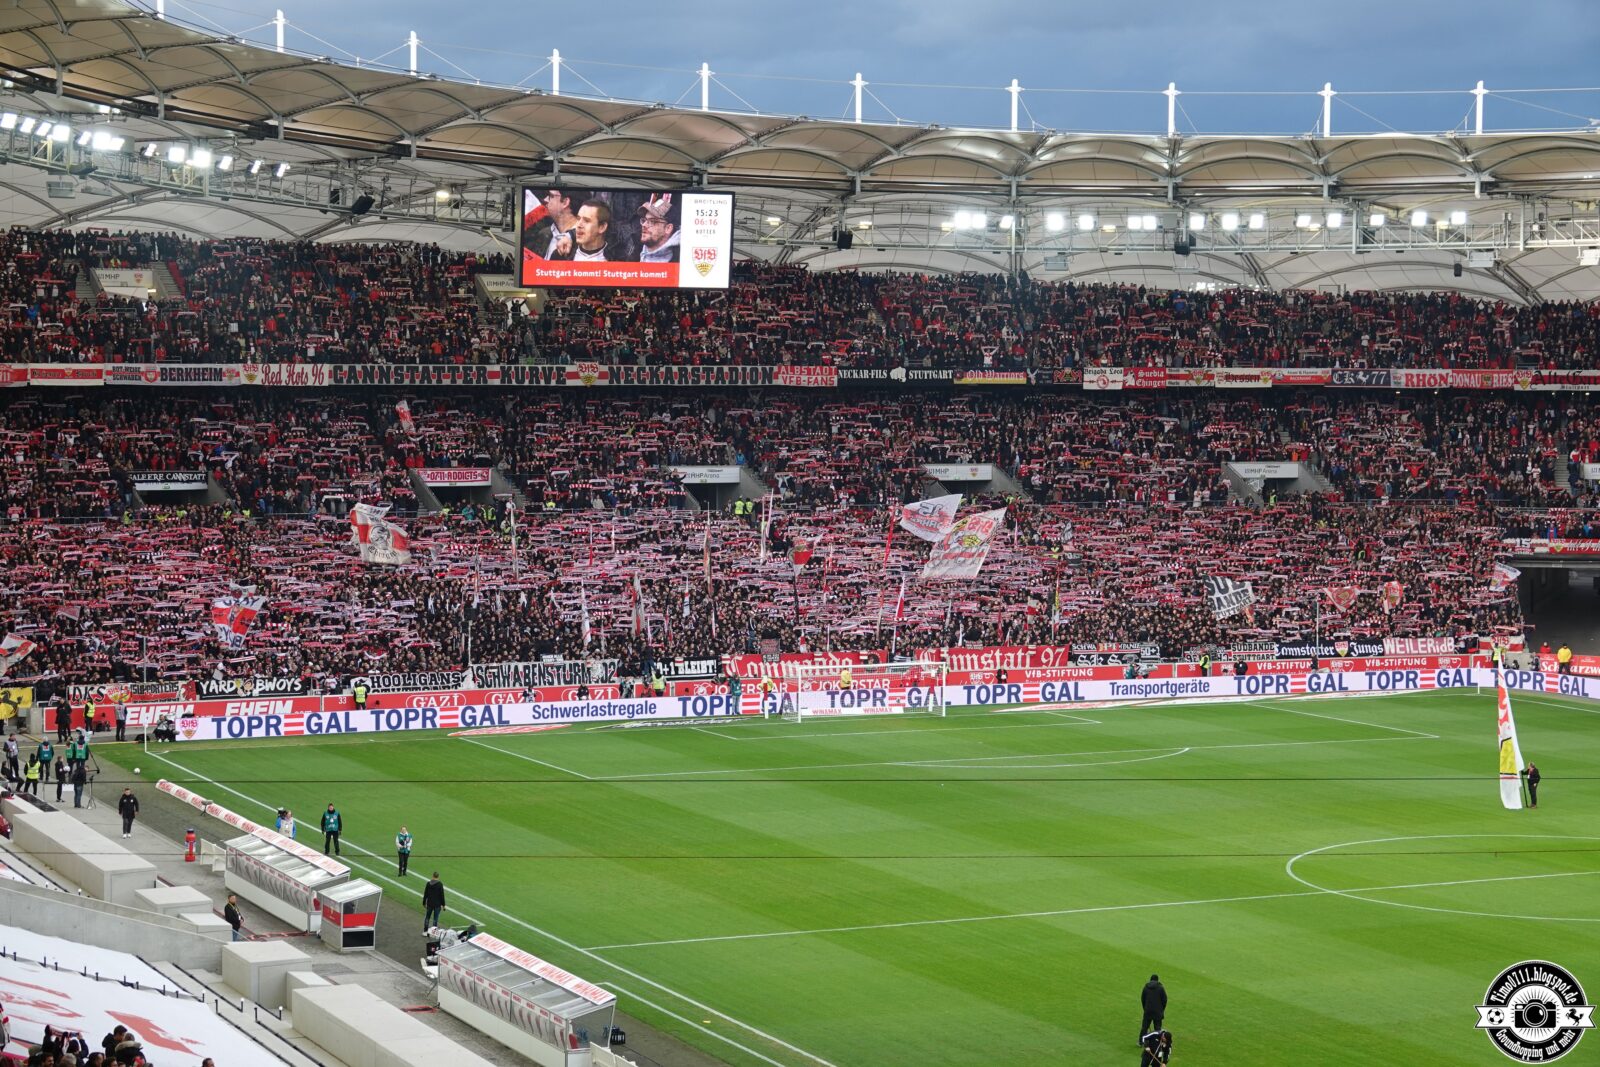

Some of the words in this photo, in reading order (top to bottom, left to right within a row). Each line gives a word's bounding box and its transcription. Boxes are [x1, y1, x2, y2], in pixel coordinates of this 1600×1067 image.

[696, 209, 719, 217] 15:23
[536, 268, 571, 279] Stuttgart
[573, 268, 601, 278] kommt!
[603, 270, 638, 279] Stuttgart
[640, 270, 667, 279] kommt!
[160, 367, 223, 382] BERKHEIM
[261, 363, 282, 385] Red
[312, 363, 325, 385] 96
[332, 365, 488, 385] CANNSTATTER
[500, 365, 567, 385] KURVE
[608, 365, 776, 385] NECKARSTADION
[780, 366, 837, 376] ALBSTADT
[838, 369, 888, 379] NECKAR-FILS
[908, 369, 954, 380] STUTTGART
[985, 370, 1025, 380] Warriors
[1371, 371, 1387, 385] 77
[781, 376, 836, 386] VFB-FANS
[1405, 372, 1450, 388] RHÖN
[1453, 373, 1482, 387] DONAU
[165, 473, 206, 481] CANNSTATT
[447, 471, 478, 480] ADDICTS
[1350, 640, 1384, 656] Jungs
[1041, 647, 1065, 668] 97
[1365, 657, 1427, 667] VfB-STIFTUNG
[369, 671, 462, 688] HOOLIGANS
[1025, 668, 1094, 678] VfB-STIFTUNG
[199, 678, 235, 695] YARD
[255, 678, 302, 692] BWOYS
[1109, 679, 1210, 698] Transportgeräte
[339, 696, 347, 704] 33
[225, 700, 294, 717] EHEIM
[532, 700, 657, 720] Schwerlastregale
